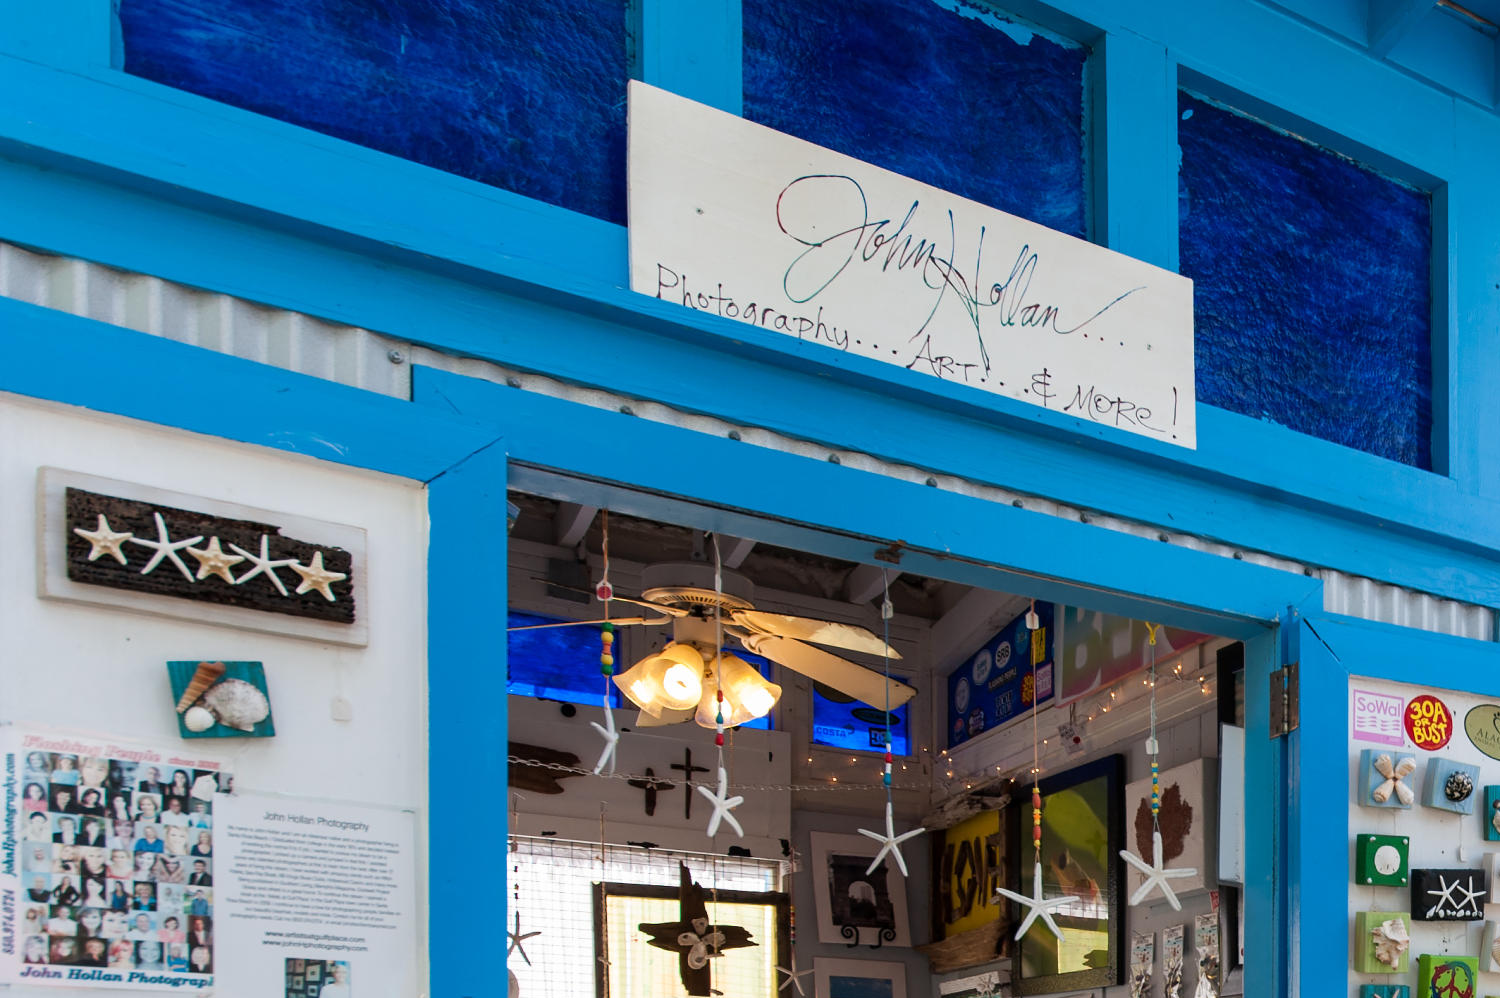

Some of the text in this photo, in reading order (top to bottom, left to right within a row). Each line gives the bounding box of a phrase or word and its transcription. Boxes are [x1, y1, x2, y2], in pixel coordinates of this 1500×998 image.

[777, 174, 936, 303] John
[1031, 368, 1056, 405] &
[1357, 697, 1401, 718] SoWal
[1410, 700, 1447, 723] 30A
[815, 726, 847, 738] COSTA
[1414, 718, 1431, 727] OR
[1412, 723, 1447, 744] BUST
[264, 811, 369, 832] John Hollan Photography
[20, 966, 63, 979] John
[67, 968, 124, 983] Hollan
